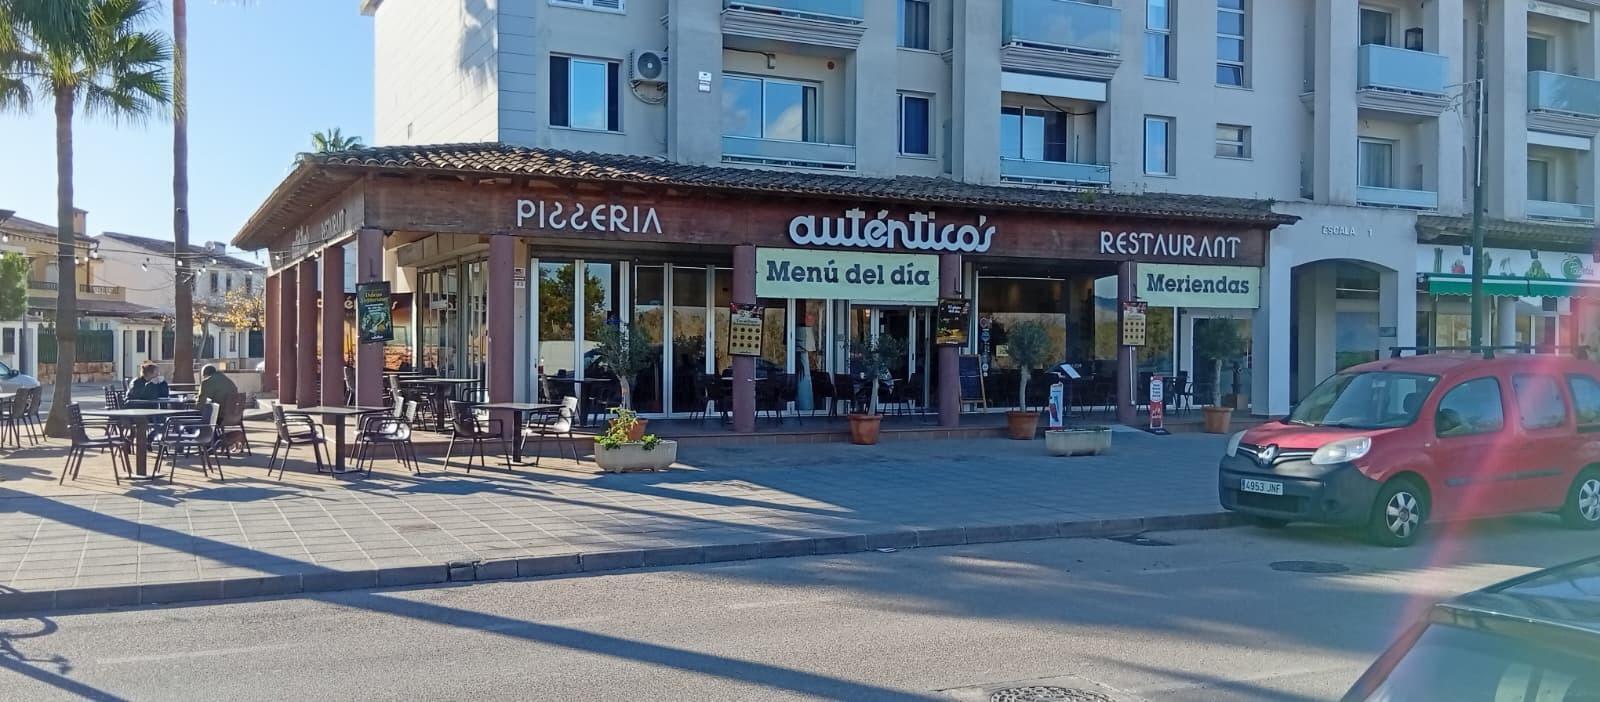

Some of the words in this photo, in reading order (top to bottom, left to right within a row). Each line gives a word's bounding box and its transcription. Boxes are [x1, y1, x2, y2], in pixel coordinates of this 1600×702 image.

[516, 199, 663, 234] PIZZERIA
[788, 208, 996, 252] auténtico's
[1100, 231, 1241, 258] RESTAURANT
[1321, 226, 1356, 236] ESCALA
[766, 259, 840, 283] Menú
[845, 264, 885, 285] del
[890, 263, 930, 286] día
[1146, 273, 1250, 294] Meriendas
[1245, 481, 1264, 491] 4953
